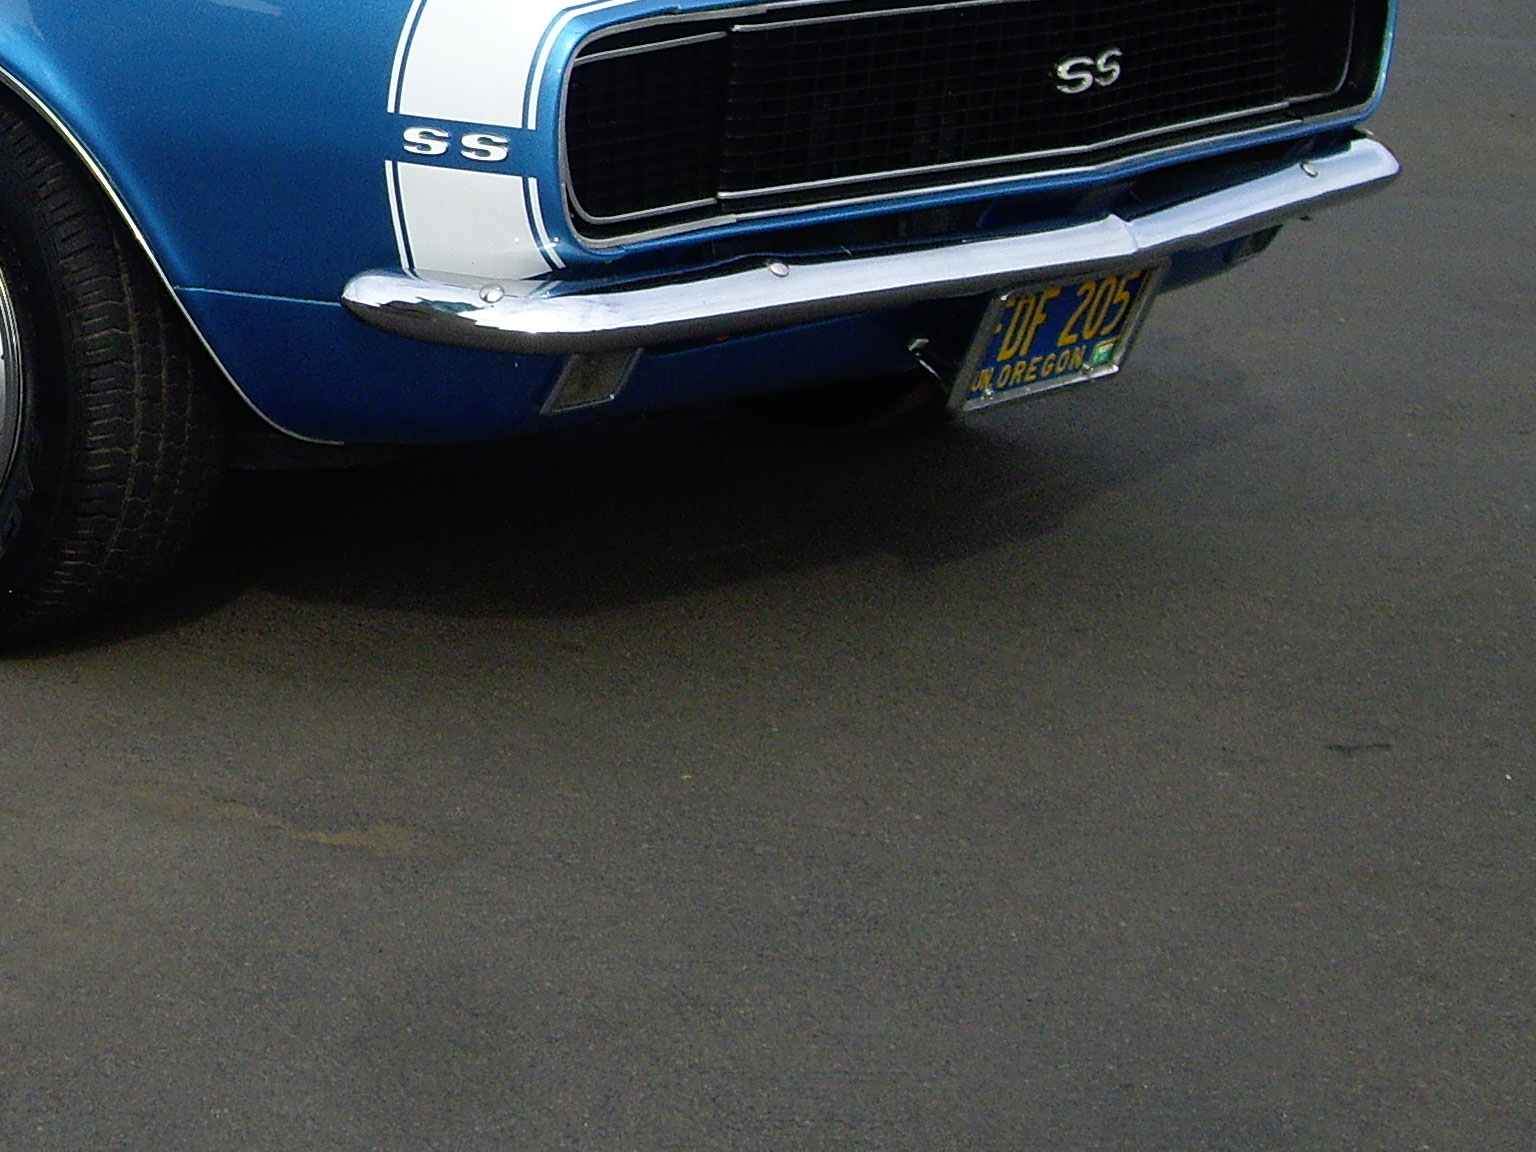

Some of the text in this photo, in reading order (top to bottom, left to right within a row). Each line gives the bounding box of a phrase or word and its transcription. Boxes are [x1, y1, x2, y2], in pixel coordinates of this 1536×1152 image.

[1056, 48, 1123, 94] SS
[402, 125, 511, 163] SS
[1057, 269, 1143, 347] 205
[997, 345, 1087, 389] OREGON
